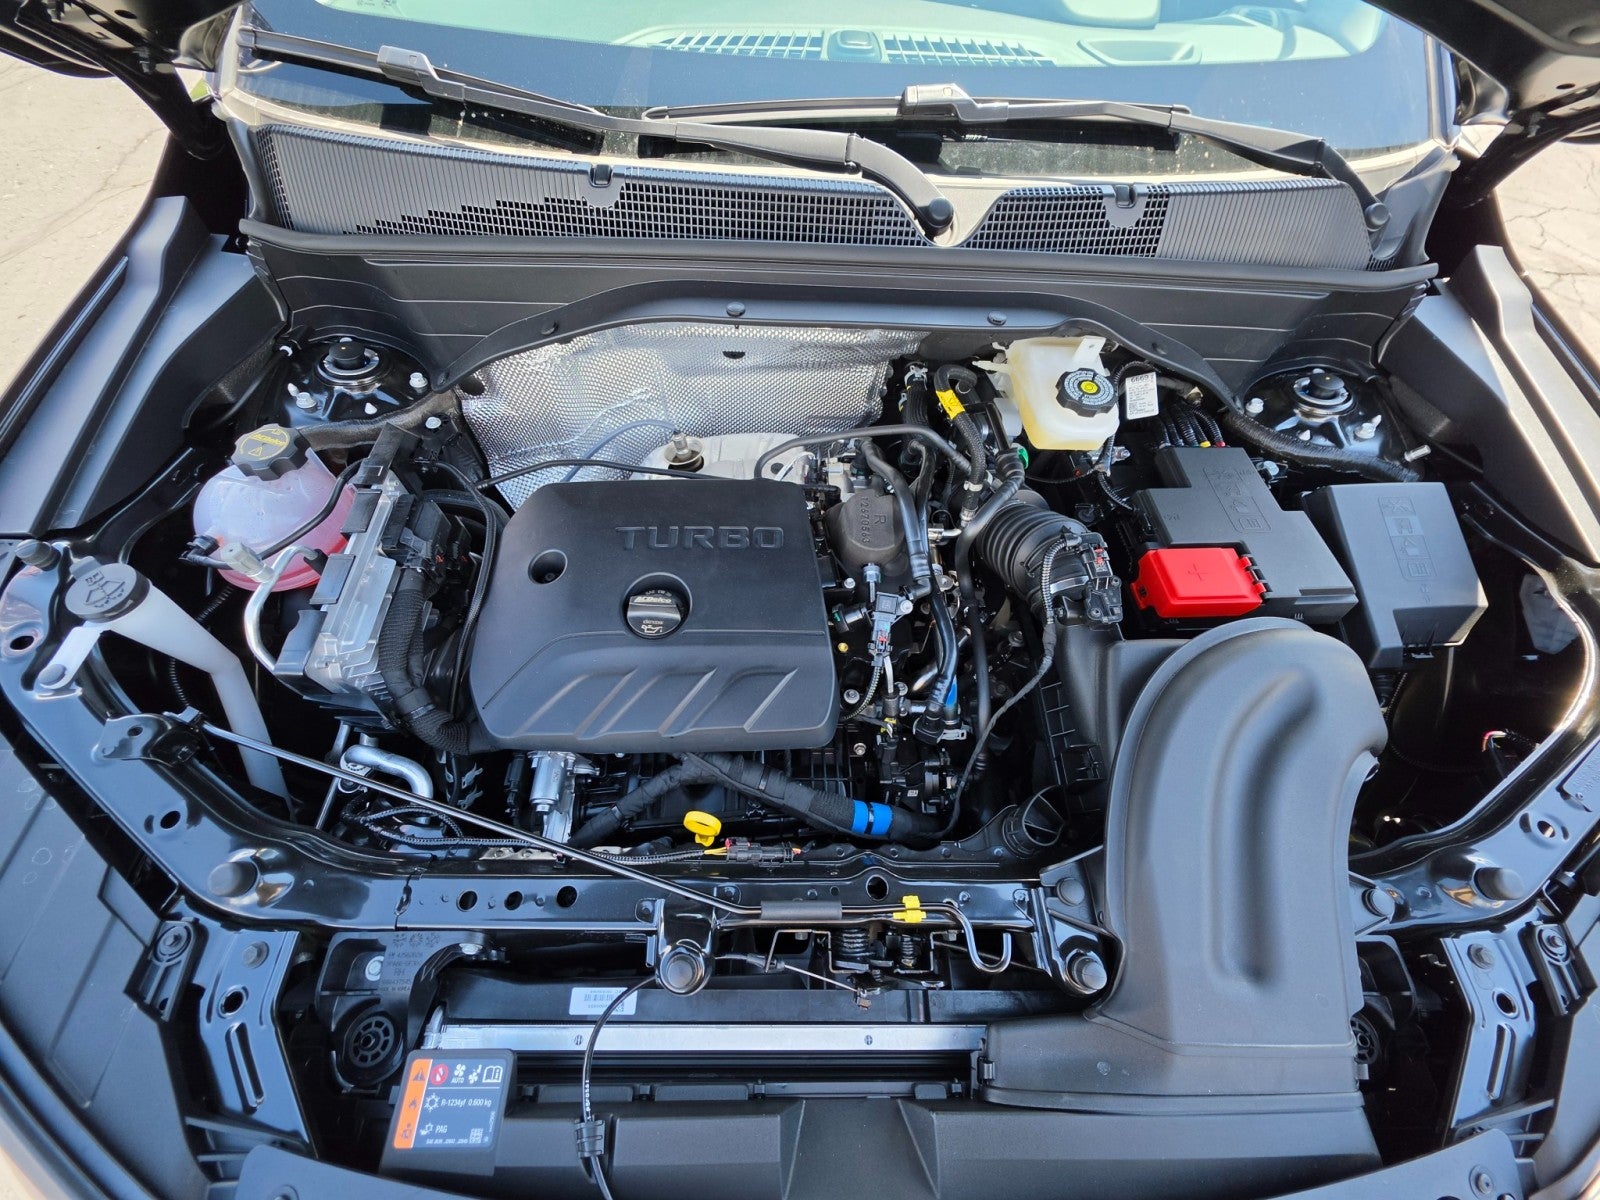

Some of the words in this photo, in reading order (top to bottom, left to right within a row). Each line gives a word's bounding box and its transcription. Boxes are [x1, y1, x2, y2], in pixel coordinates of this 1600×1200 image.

[860, 496, 871, 544] 12670563
[874, 514, 887, 526] R
[615, 526, 784, 550] TURBO
[634, 596, 672, 604] ACDelco
[440, 1099, 466, 1108] R-1234yf
[484, 1099, 492, 1108] kg
[435, 1124, 448, 1134] PAG
